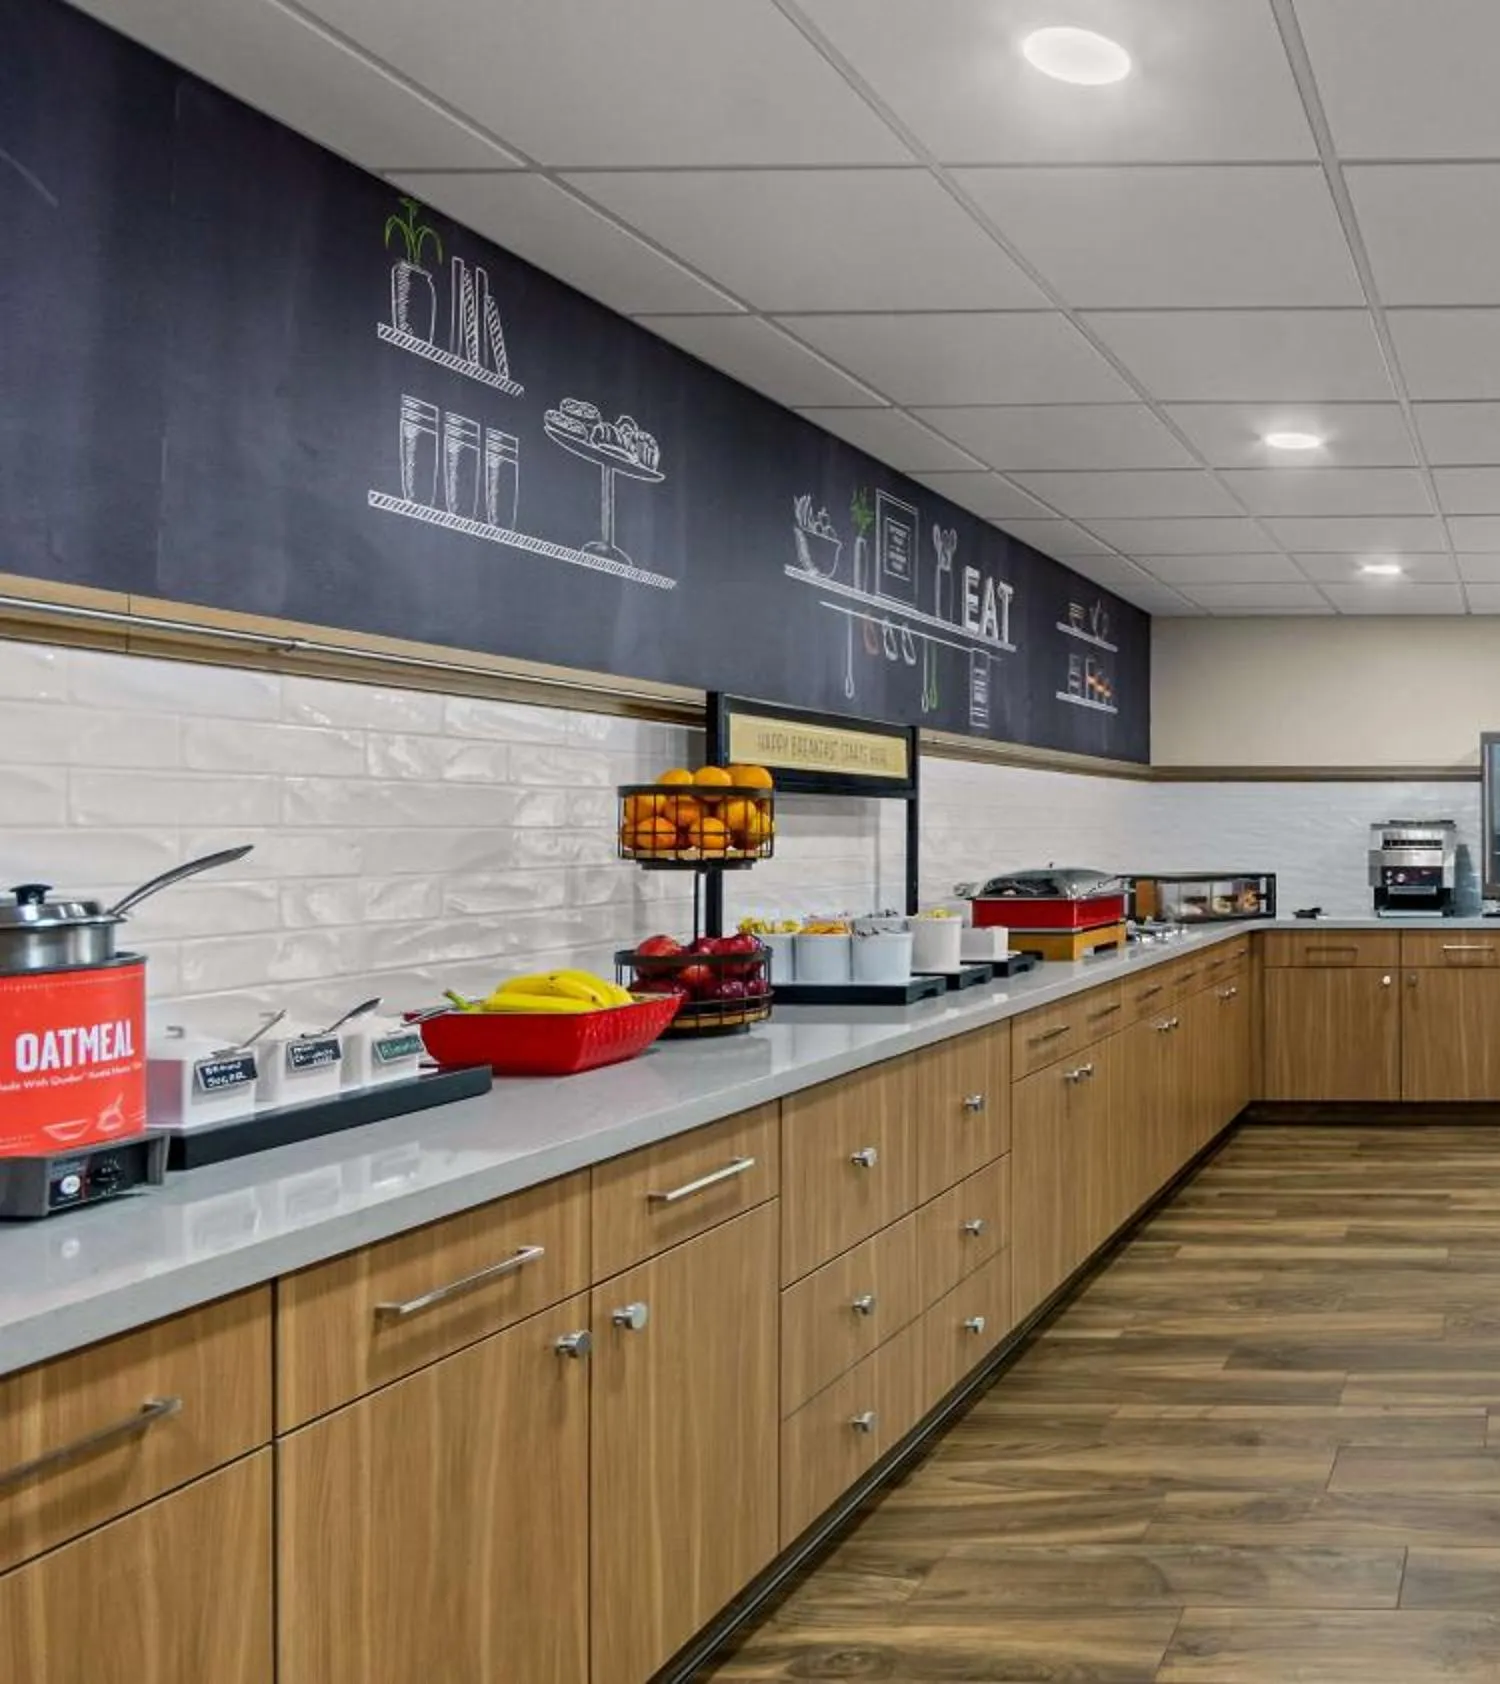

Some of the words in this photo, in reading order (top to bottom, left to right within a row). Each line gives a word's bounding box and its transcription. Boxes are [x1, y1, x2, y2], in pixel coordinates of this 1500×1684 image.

[962, 565, 1014, 645] EAT
[757, 732, 787, 754] HAPPY
[15, 1018, 135, 1073] OATMEAL
